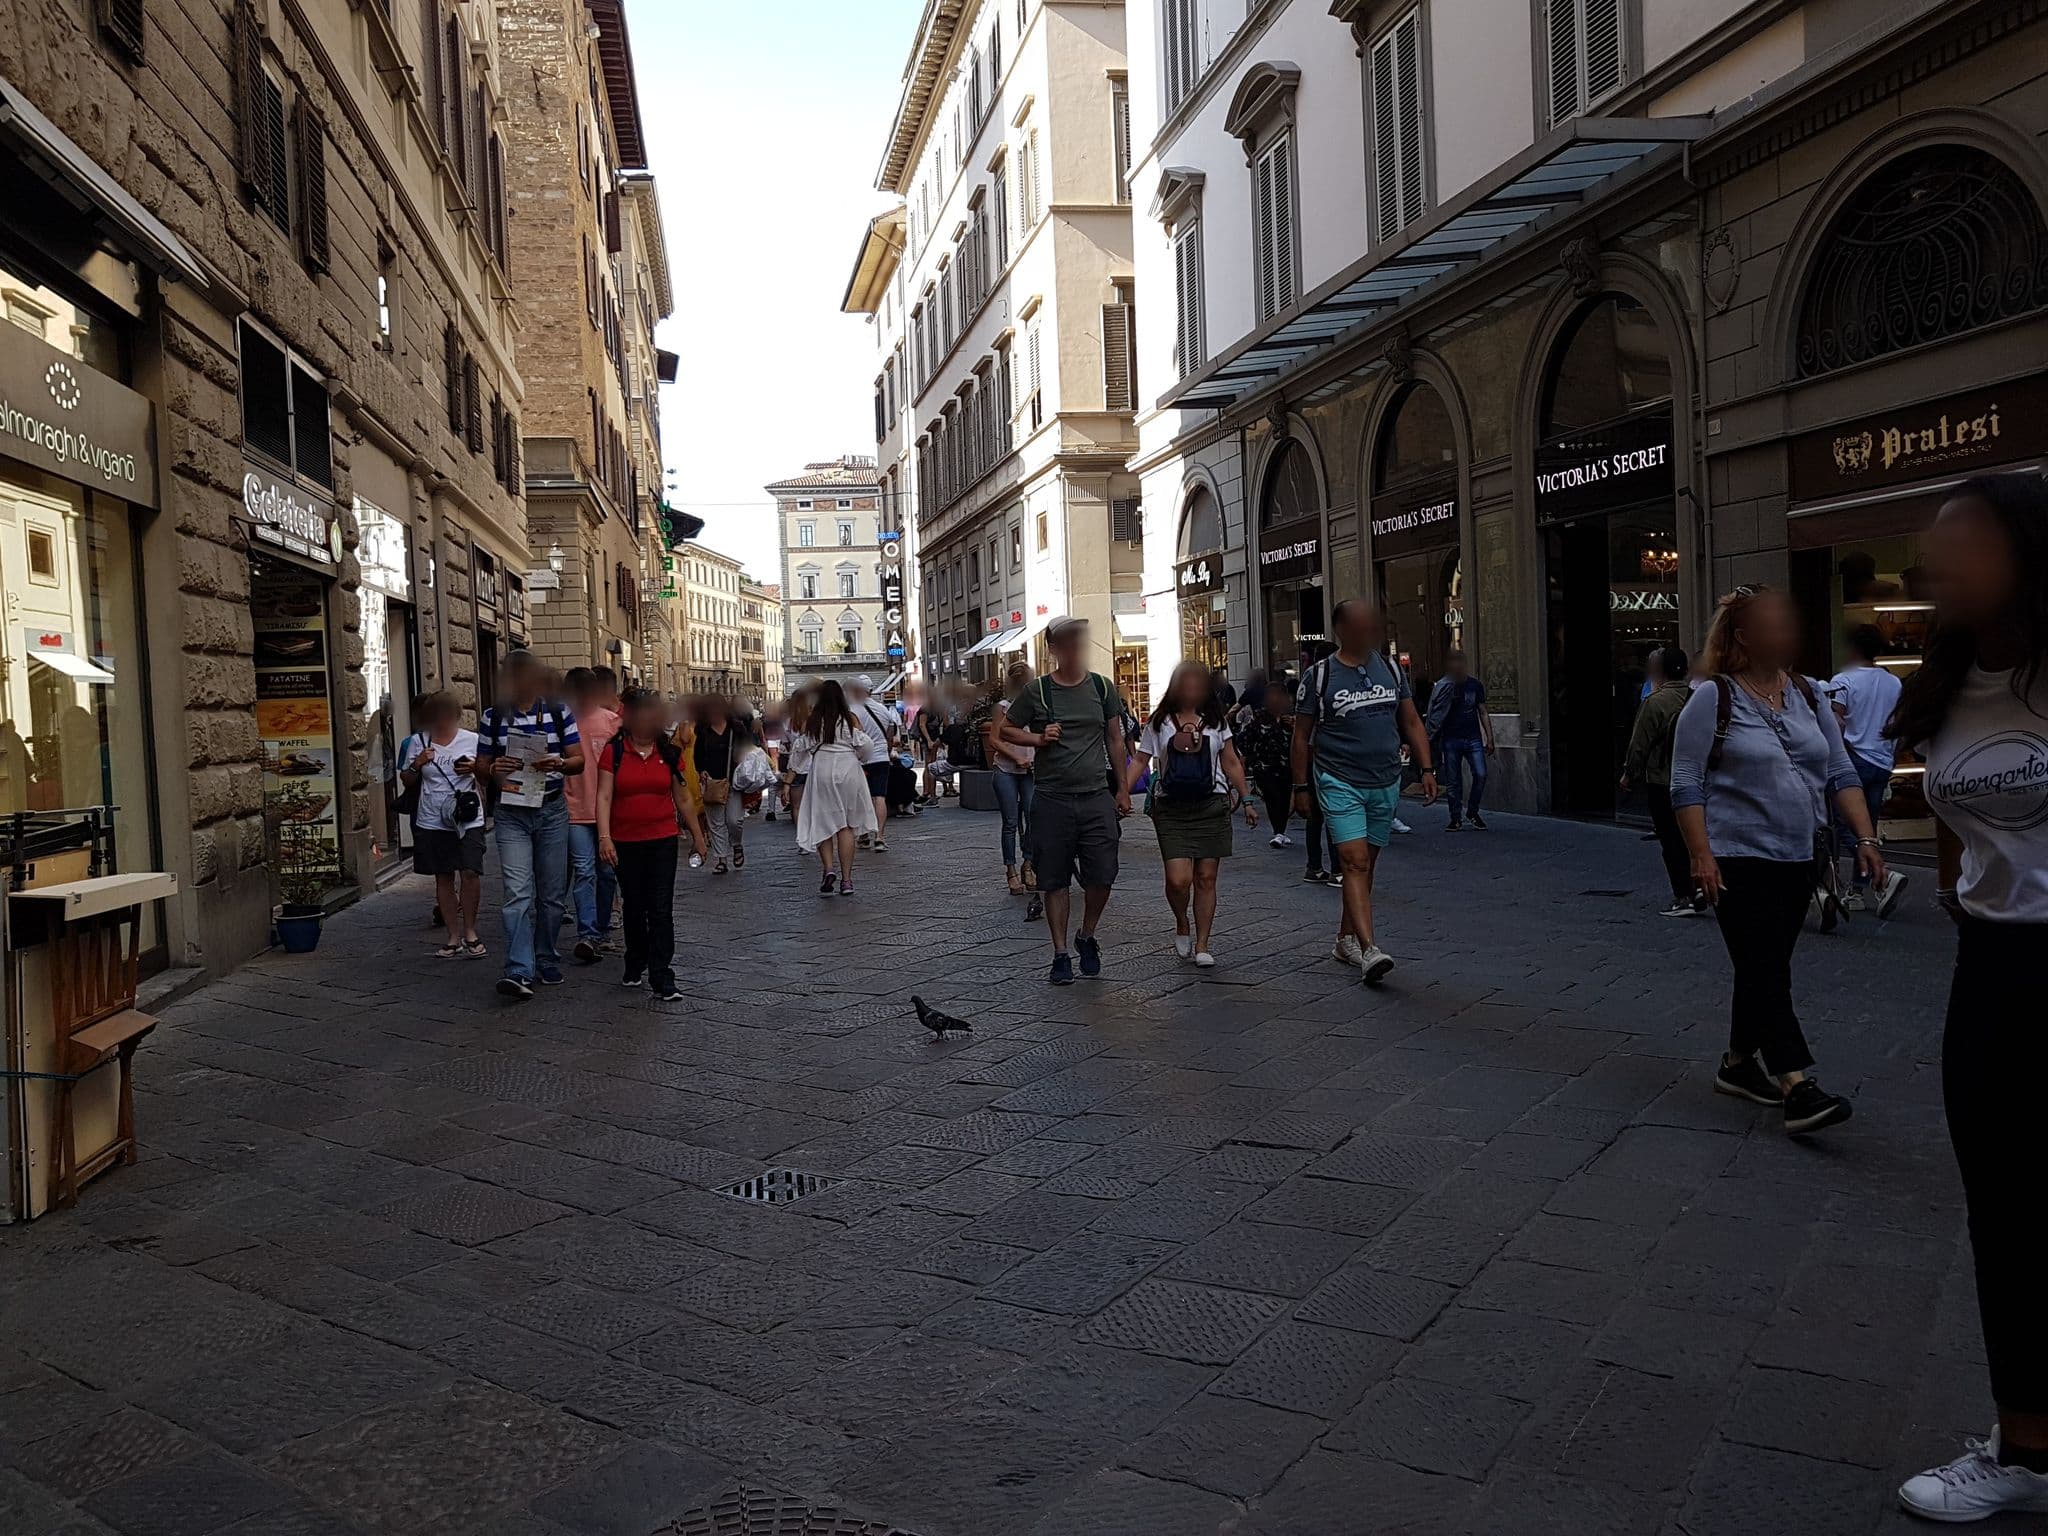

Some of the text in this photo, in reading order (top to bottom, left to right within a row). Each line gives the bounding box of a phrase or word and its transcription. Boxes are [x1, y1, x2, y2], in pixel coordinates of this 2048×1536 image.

[78, 433, 91, 465] &
[1880, 403, 2001, 470] Pratesi
[1535, 444, 1668, 496] VICTORIA'S SECRET
[243, 472, 327, 546] Gelateria
[1371, 501, 1455, 537] VICTORIA'S SECRET
[1260, 539, 1318, 566] VICTORIA'S SECRET
[883, 541, 903, 647] OMEGA
[269, 674, 312, 683] PATATINE
[278, 739, 311, 747] WAFFEL
